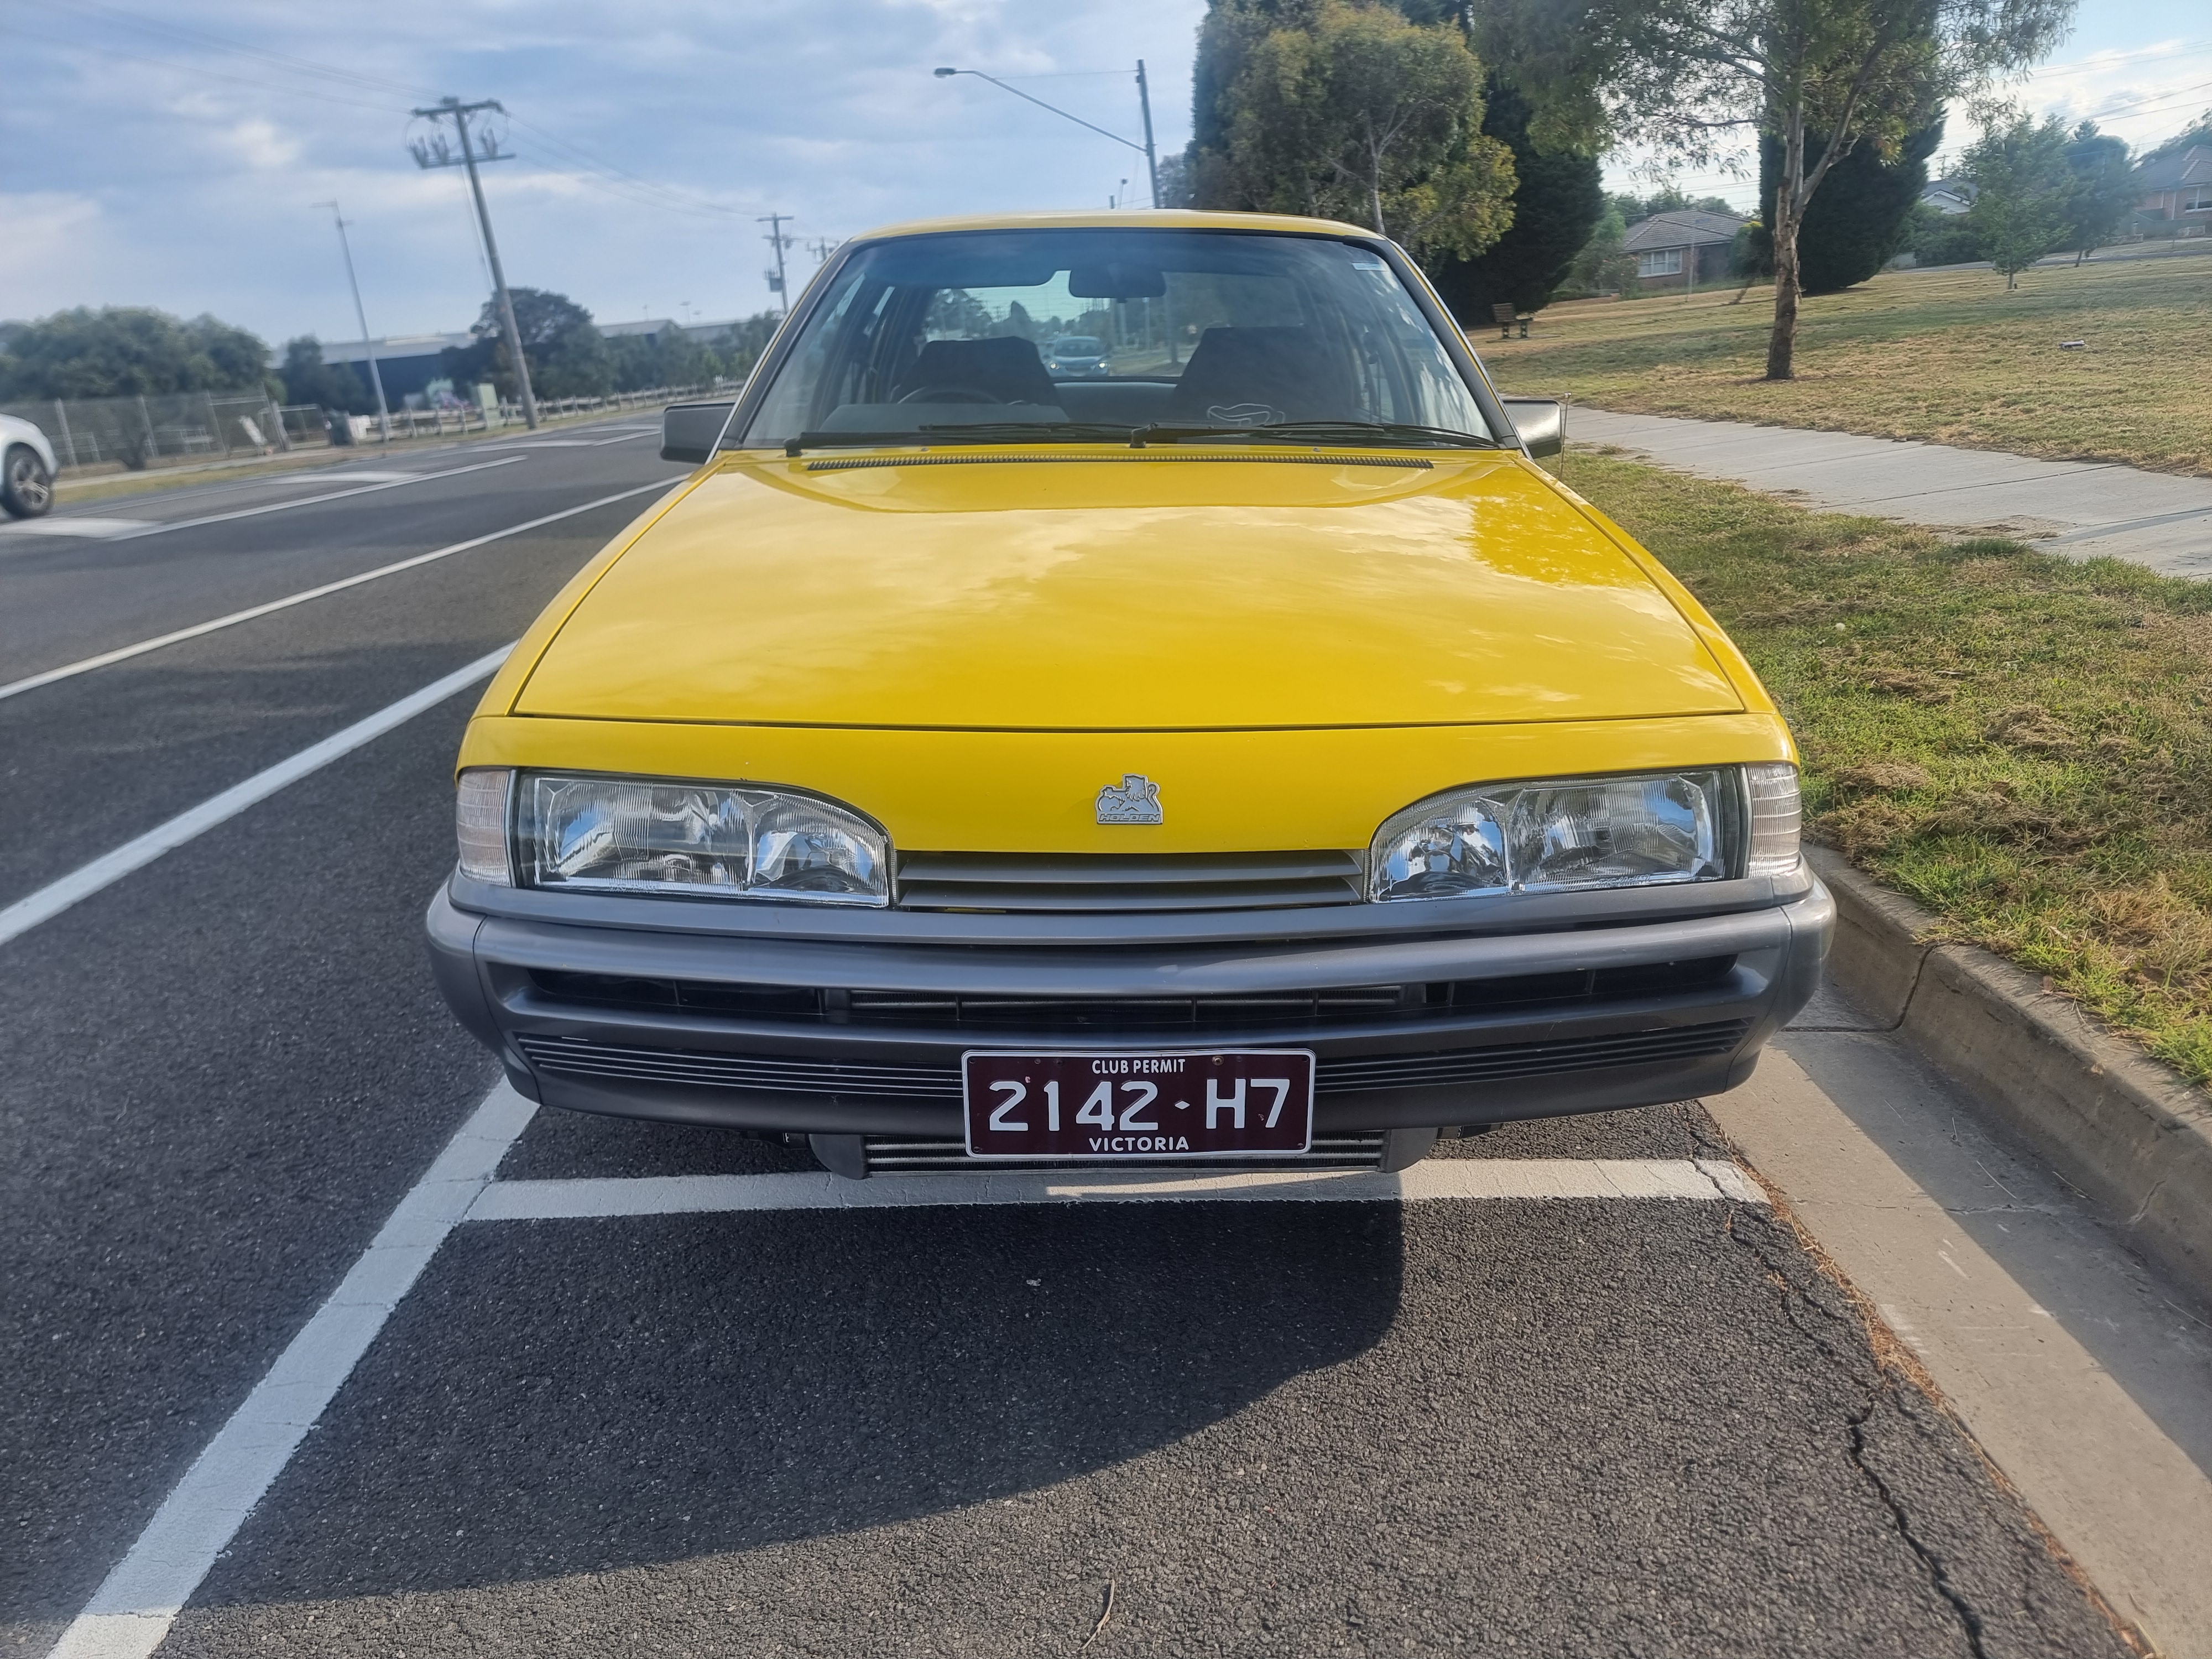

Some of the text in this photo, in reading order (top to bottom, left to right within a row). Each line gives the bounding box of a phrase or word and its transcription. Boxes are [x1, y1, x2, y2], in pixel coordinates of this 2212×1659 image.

[1099, 813, 1160, 822] HOLDEN
[1092, 1059, 1186, 1074] CLUB PERMIT
[1089, 1136, 1189, 1152] VICTORIA
